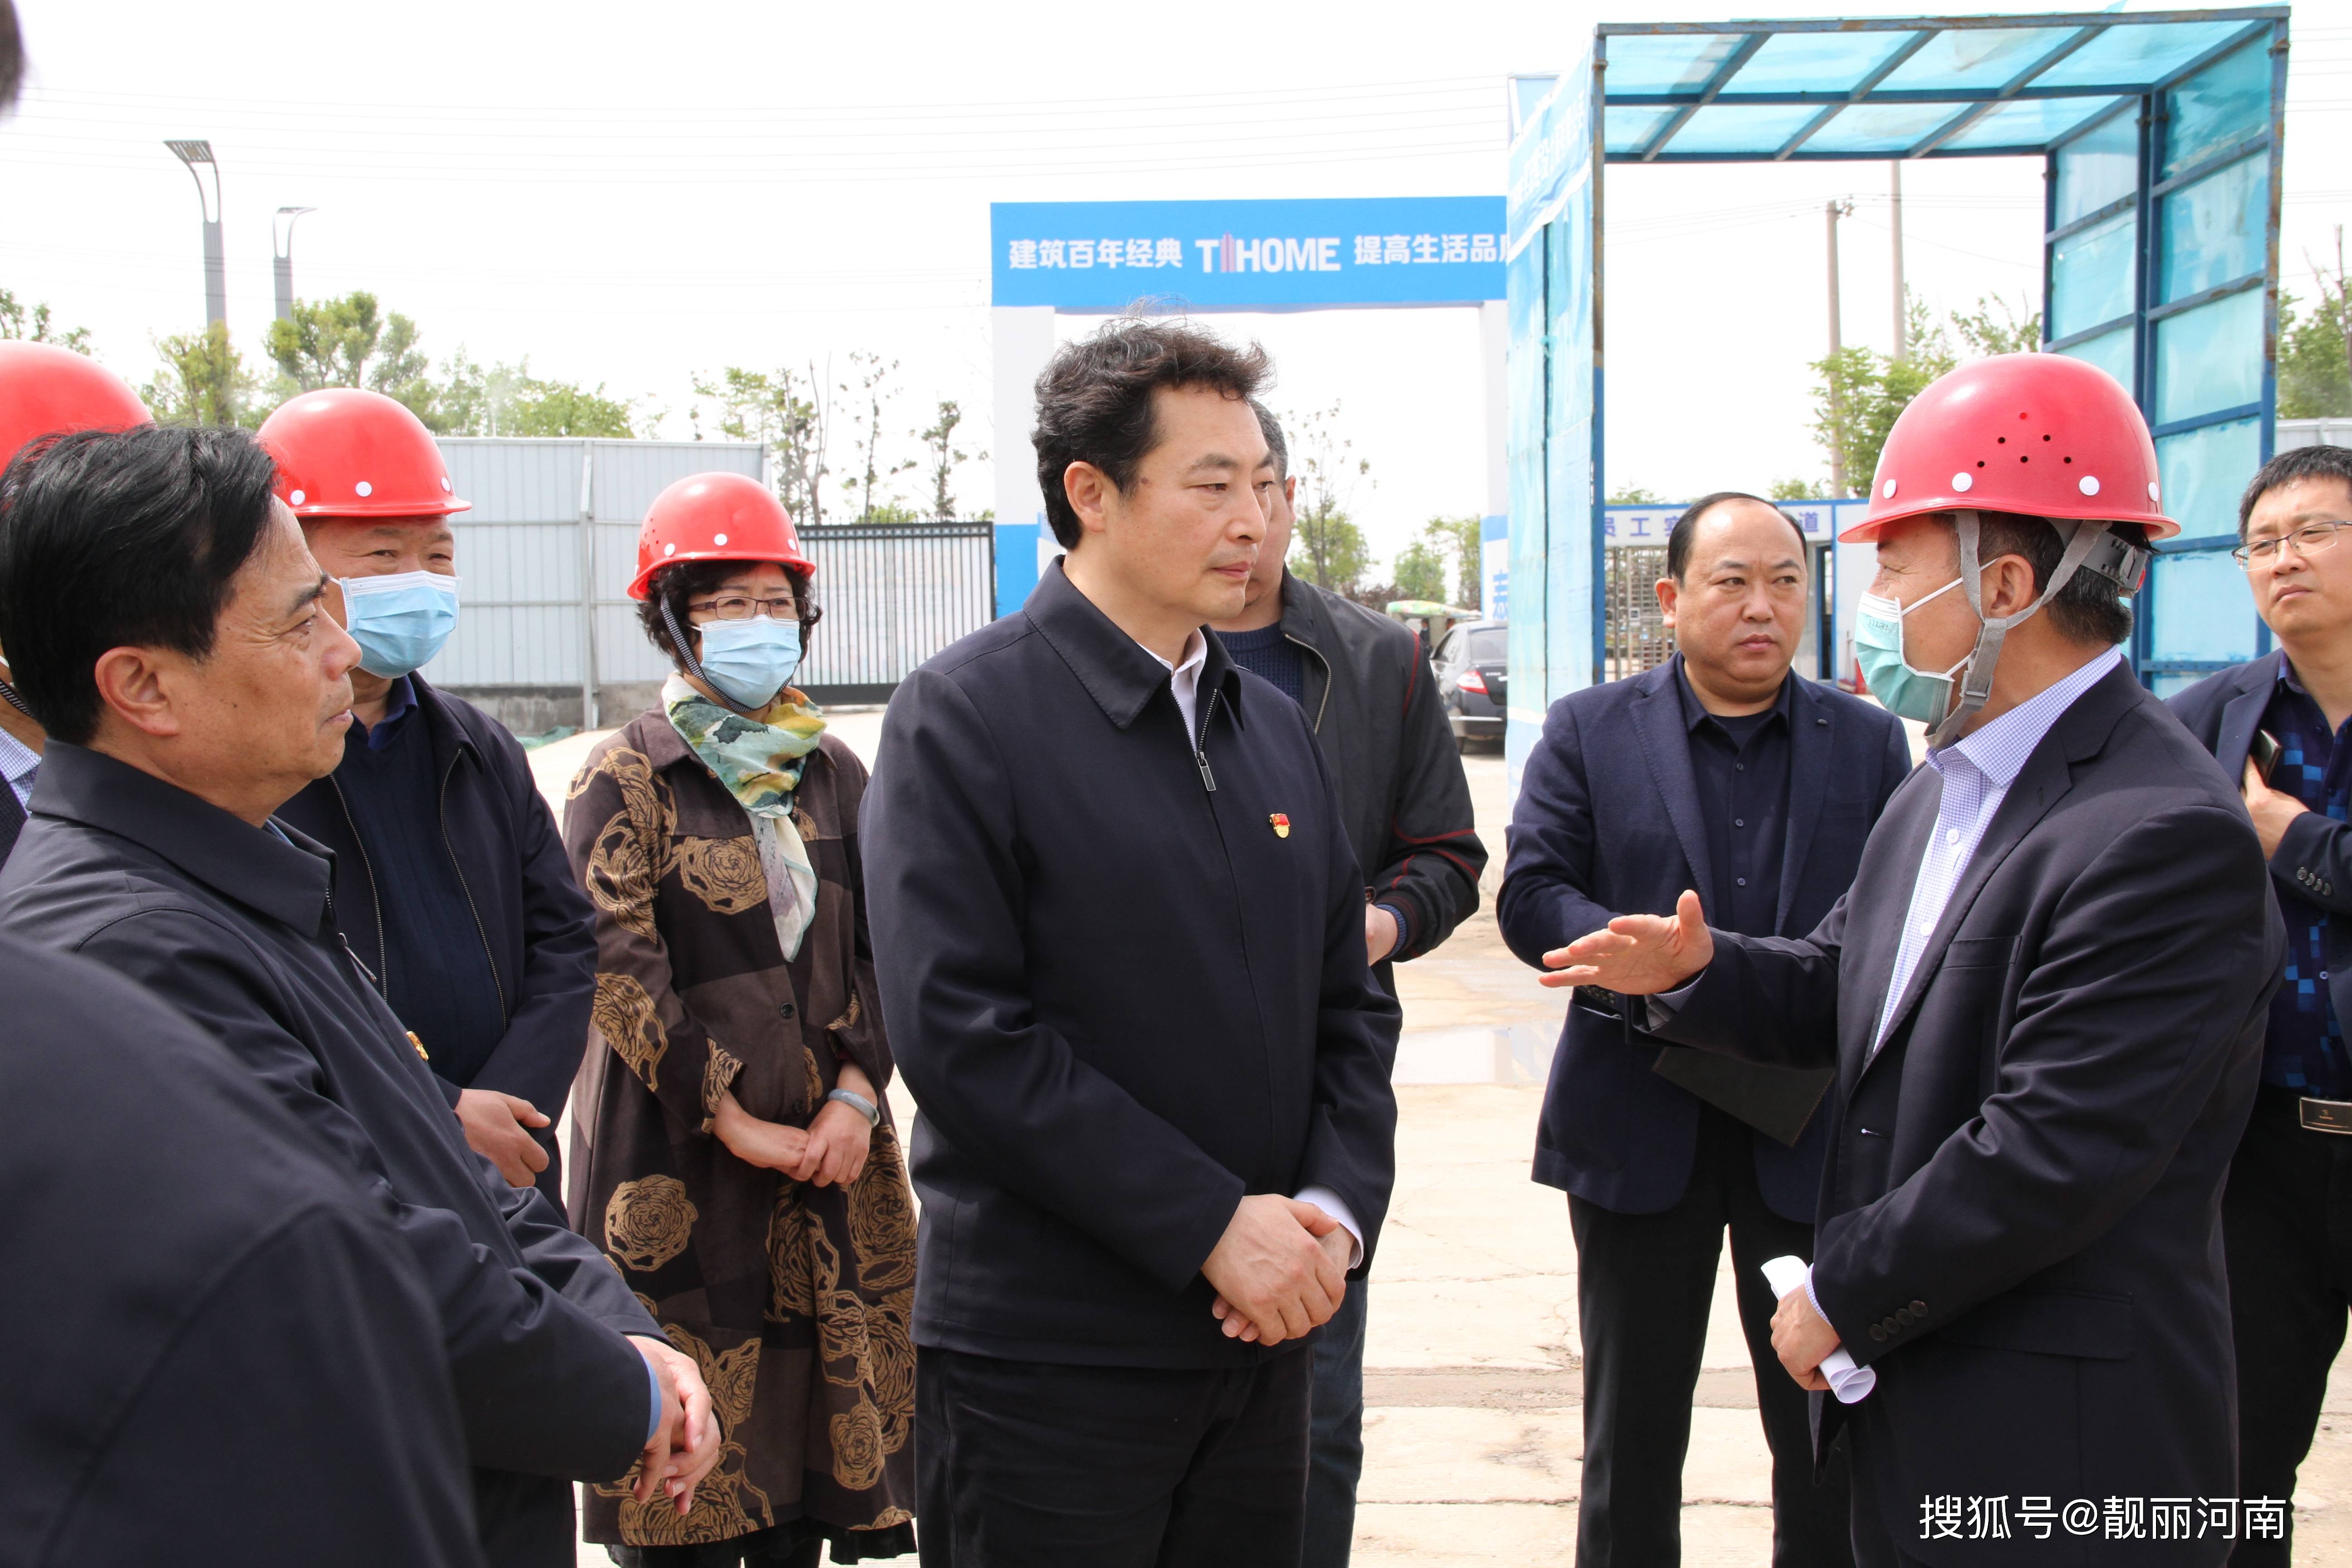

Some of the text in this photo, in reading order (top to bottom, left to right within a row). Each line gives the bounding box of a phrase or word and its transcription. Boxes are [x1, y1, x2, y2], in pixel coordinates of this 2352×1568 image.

[1009, 238, 1183, 269] 建筑百年经典
